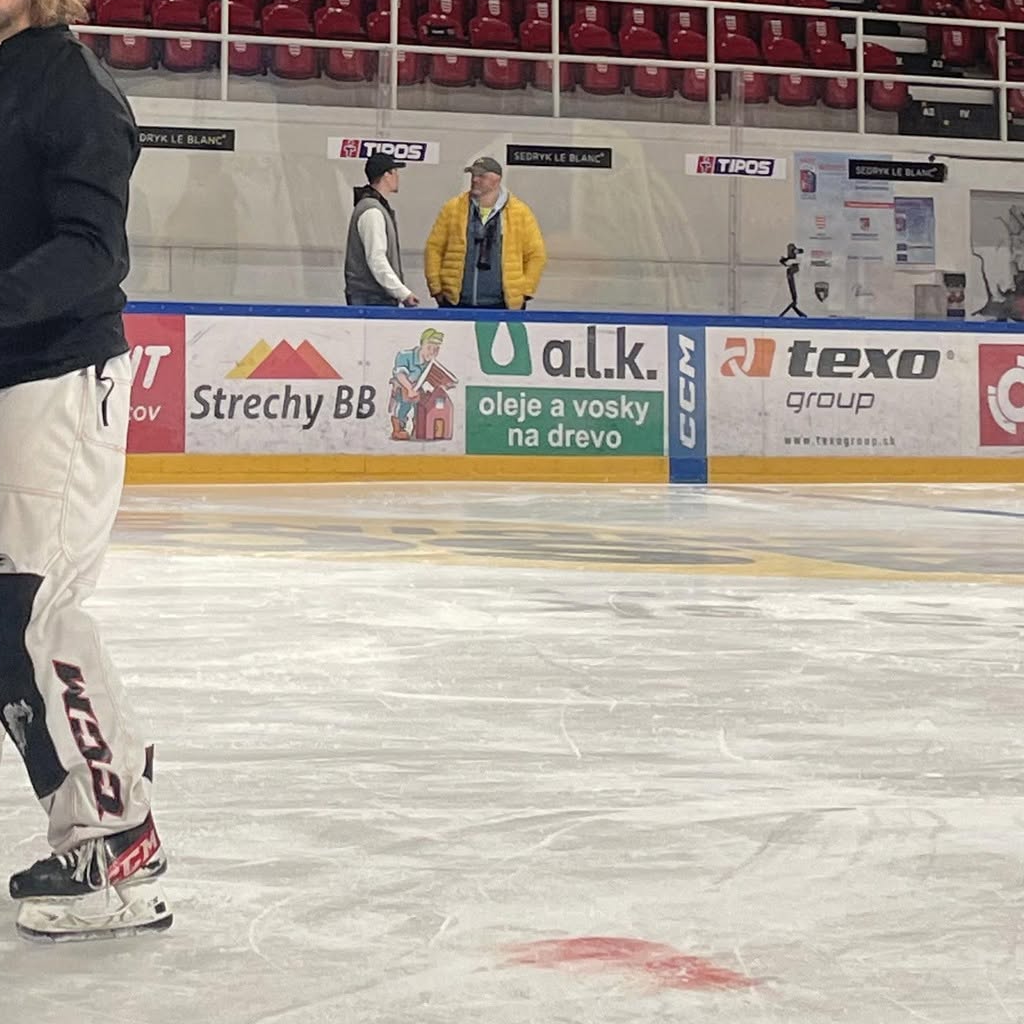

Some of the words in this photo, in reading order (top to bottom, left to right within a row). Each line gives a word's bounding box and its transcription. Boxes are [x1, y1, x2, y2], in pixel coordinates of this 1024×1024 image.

[138, 133, 169, 143] DRYK
[363, 142, 423, 160] TIPOS
[718, 158, 772, 175] TIPOS
[542, 326, 658, 380] a.l.k.
[787, 340, 941, 380] texo
[190, 384, 324, 430] Strechy
[333, 385, 376, 419] BB
[678, 334, 696, 450] CCM
[786, 391, 875, 414] group
[478, 391, 543, 423] oleje
[550, 398, 566, 418] a
[573, 394, 650, 426] vosky
[508, 426, 540, 447] na
[547, 423, 622, 449] drevo
